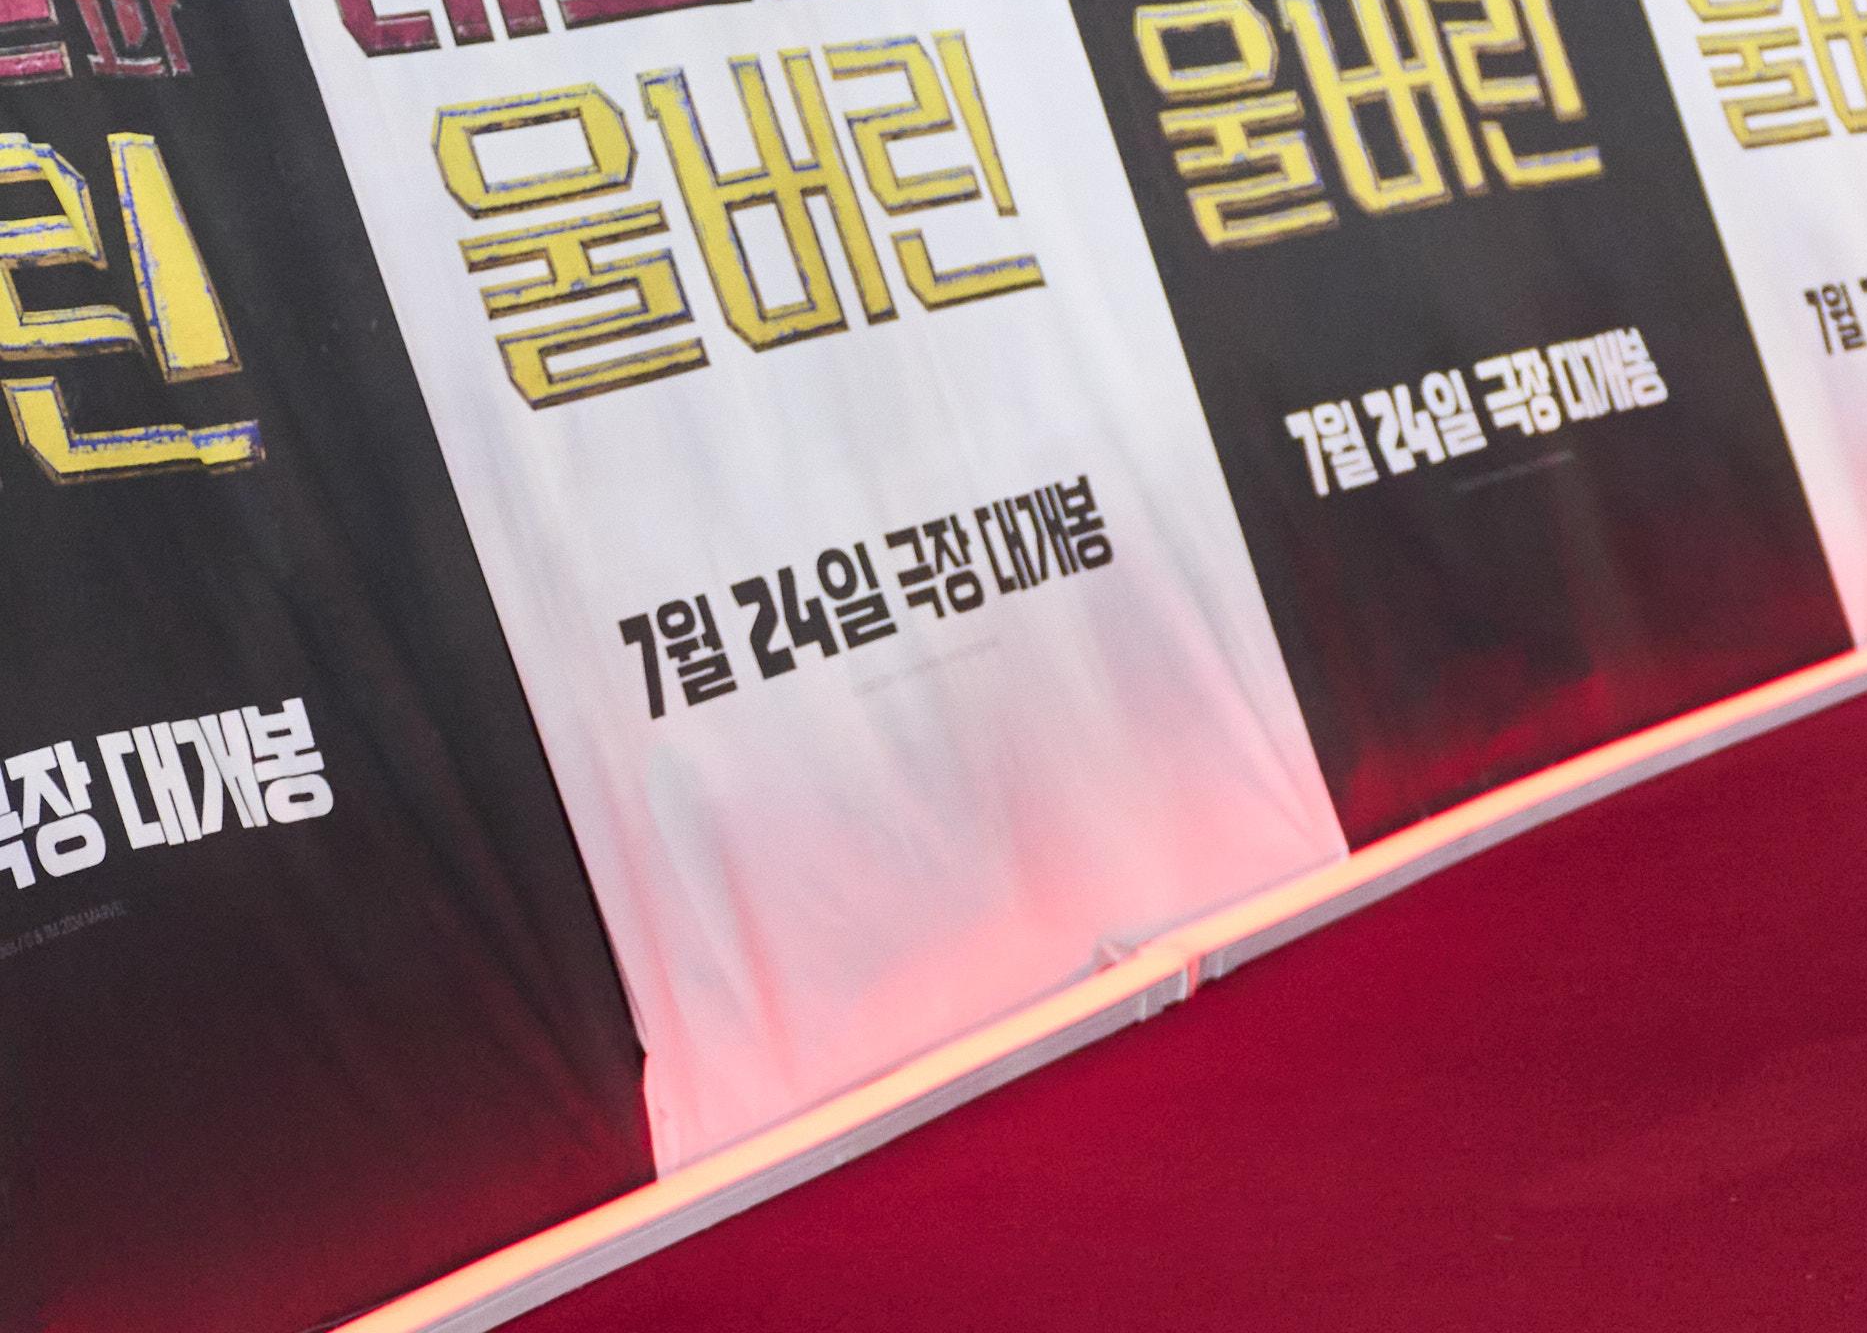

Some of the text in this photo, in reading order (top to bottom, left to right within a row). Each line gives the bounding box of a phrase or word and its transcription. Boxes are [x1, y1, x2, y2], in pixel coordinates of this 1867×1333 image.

[431, 30, 1046, 411] 울버린
[1804, 281, 1867, 356] 7월
[1285, 327, 1669, 497] 7월 24일 극장 대개봉
[620, 595, 738, 719] 7월
[733, 543, 898, 681] 24일
[886, 513, 987, 617] 극장
[975, 474, 1116, 593] 대개봉
[97, 697, 336, 847] 대개봉
